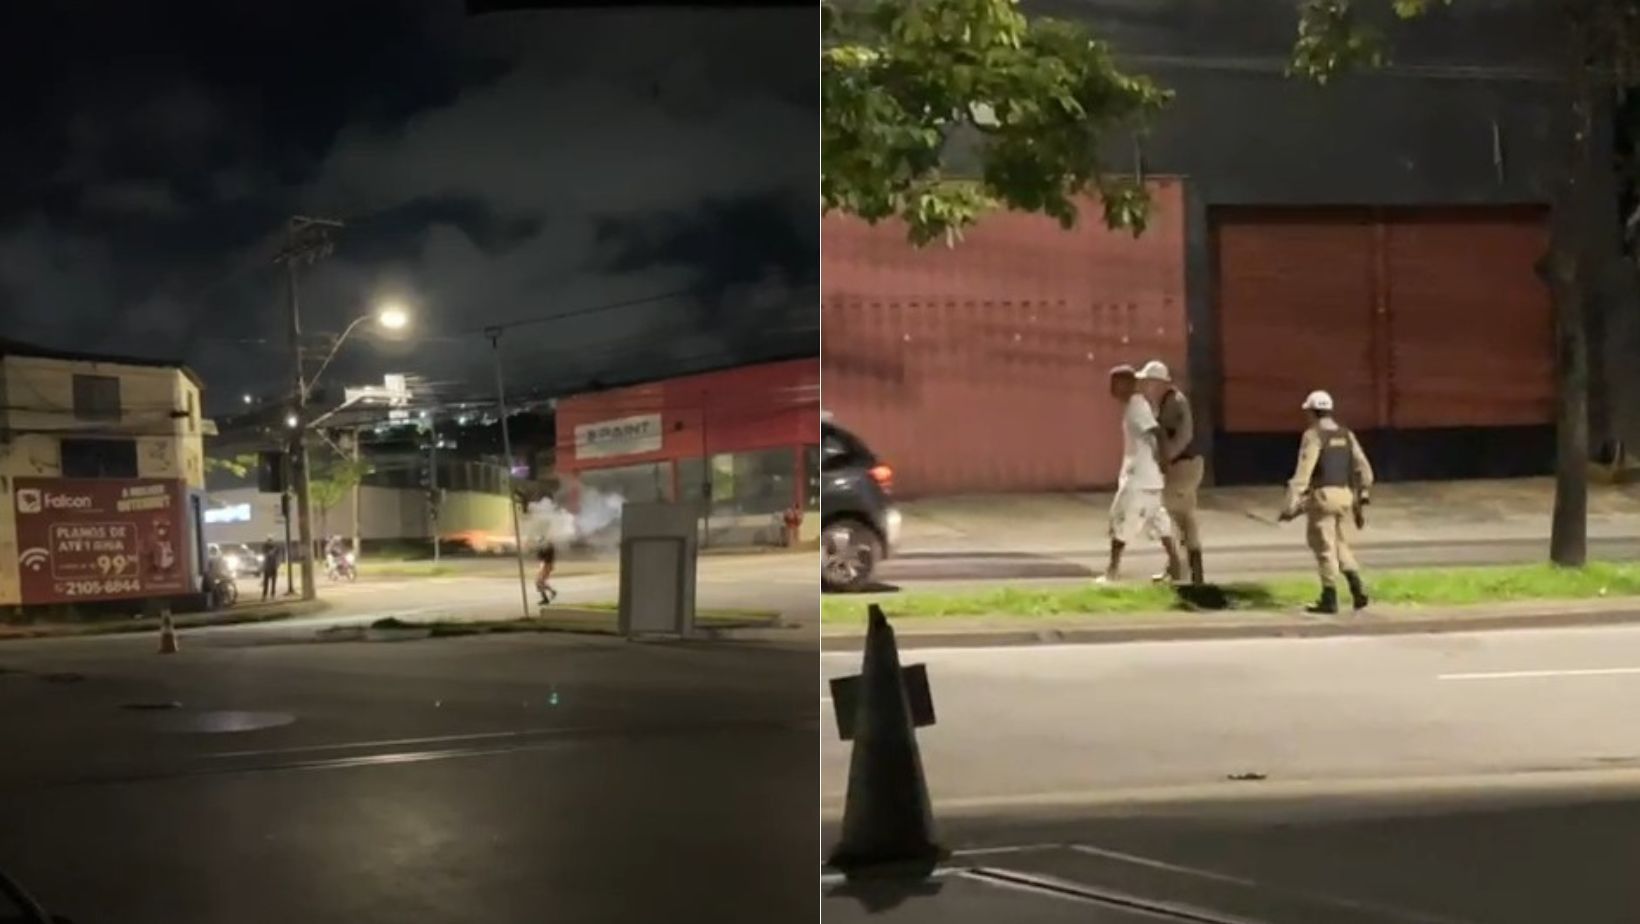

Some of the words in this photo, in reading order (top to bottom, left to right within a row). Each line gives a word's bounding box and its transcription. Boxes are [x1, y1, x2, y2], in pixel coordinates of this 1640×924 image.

[44, 494, 92, 508] Falcon
[57, 526, 105, 538] PLANOS
[110, 526, 126, 538] DE
